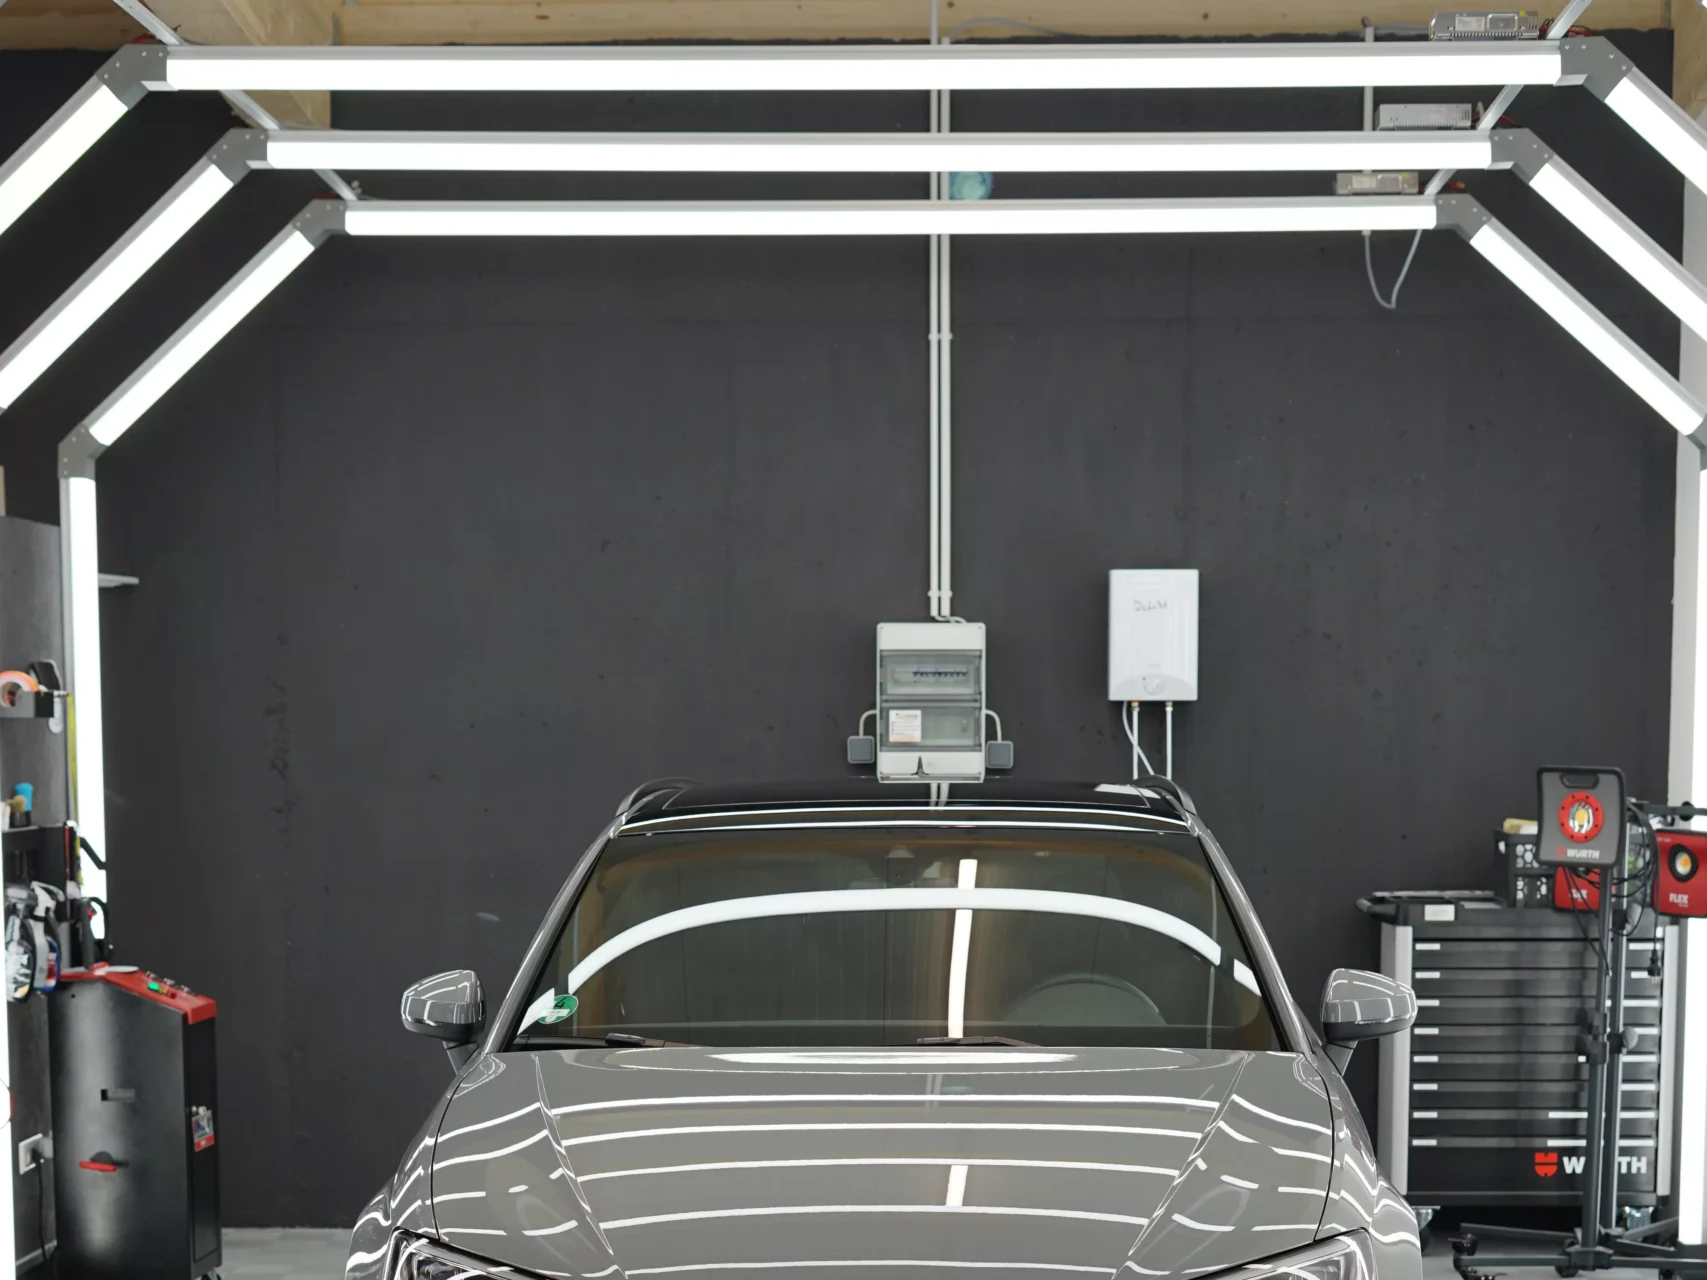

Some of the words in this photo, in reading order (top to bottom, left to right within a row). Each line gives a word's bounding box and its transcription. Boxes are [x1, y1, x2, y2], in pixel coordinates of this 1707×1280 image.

[1669, 893, 1689, 904] FLEX
[554, 997, 567, 1009] 4
[1562, 1156, 1647, 1174] WTH
